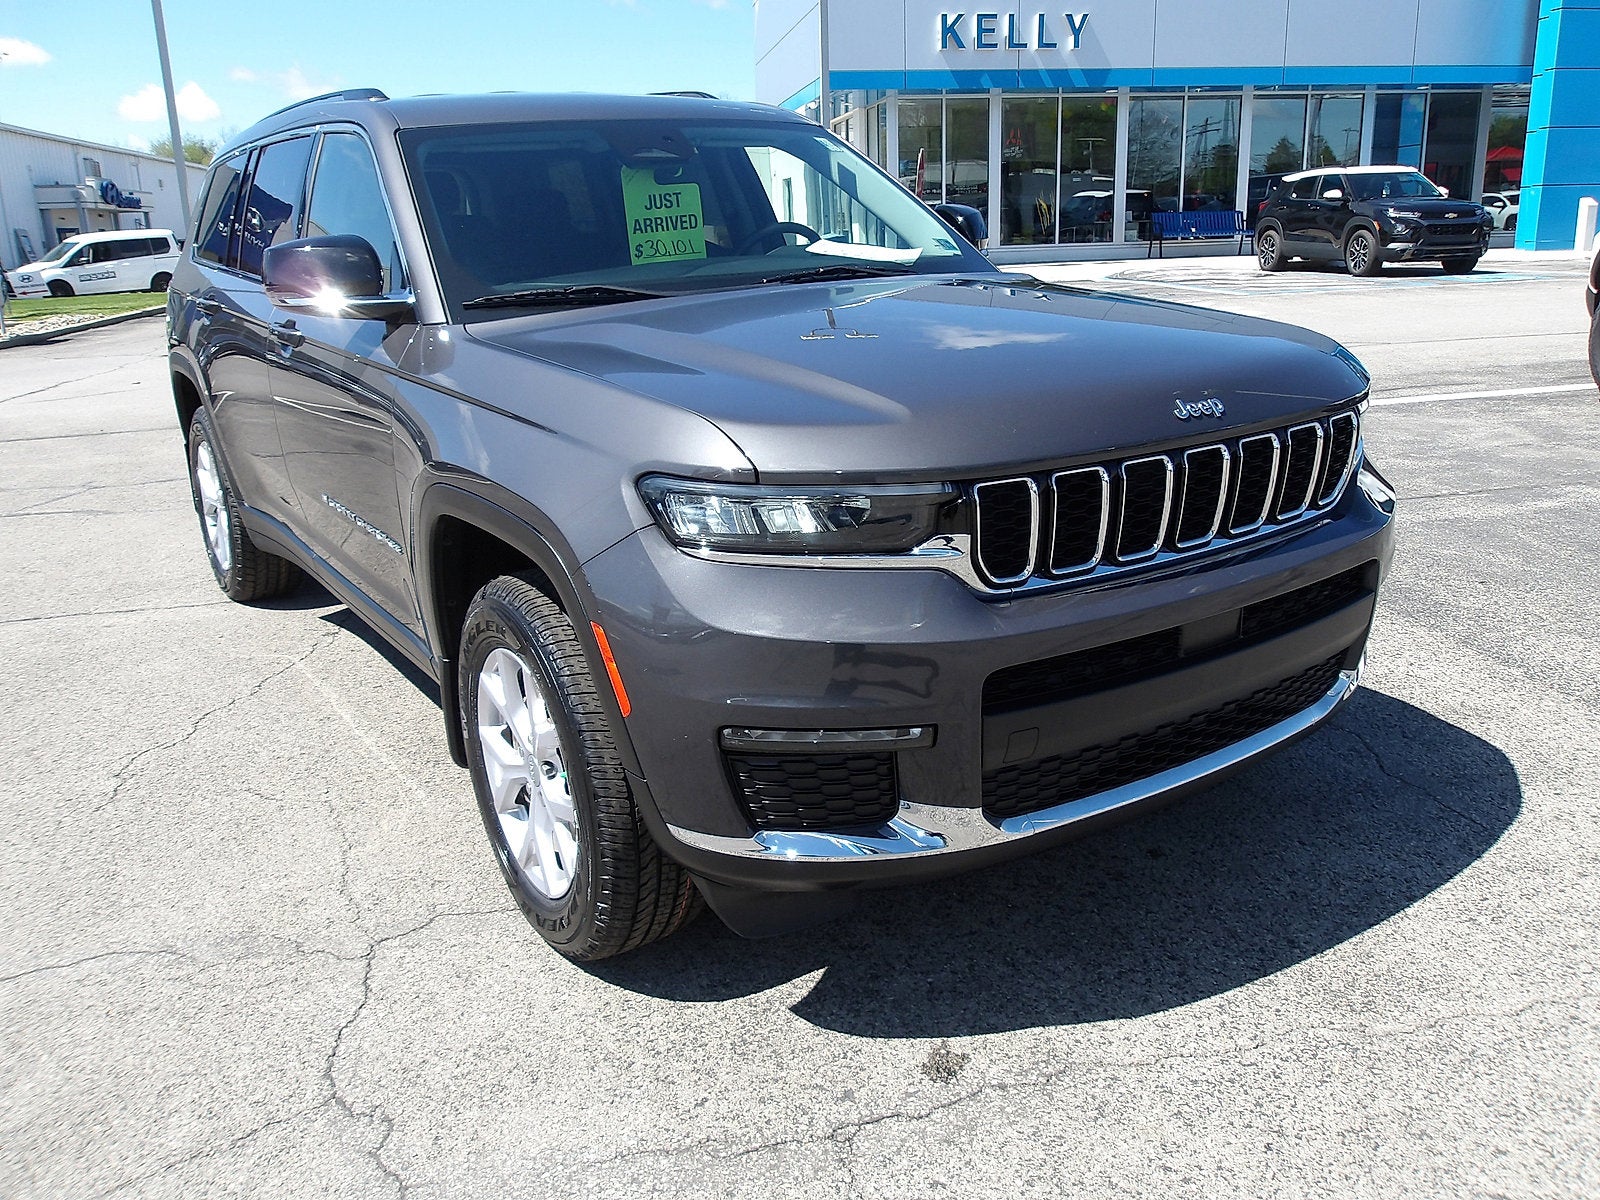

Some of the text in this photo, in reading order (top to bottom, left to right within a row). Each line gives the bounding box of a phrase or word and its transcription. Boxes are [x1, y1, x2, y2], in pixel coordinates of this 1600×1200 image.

[938, 13, 1089, 50] KELLY
[645, 192, 682, 211] JUST
[633, 213, 698, 234] ARRIVED
[1174, 398, 1225, 418] Jeep
